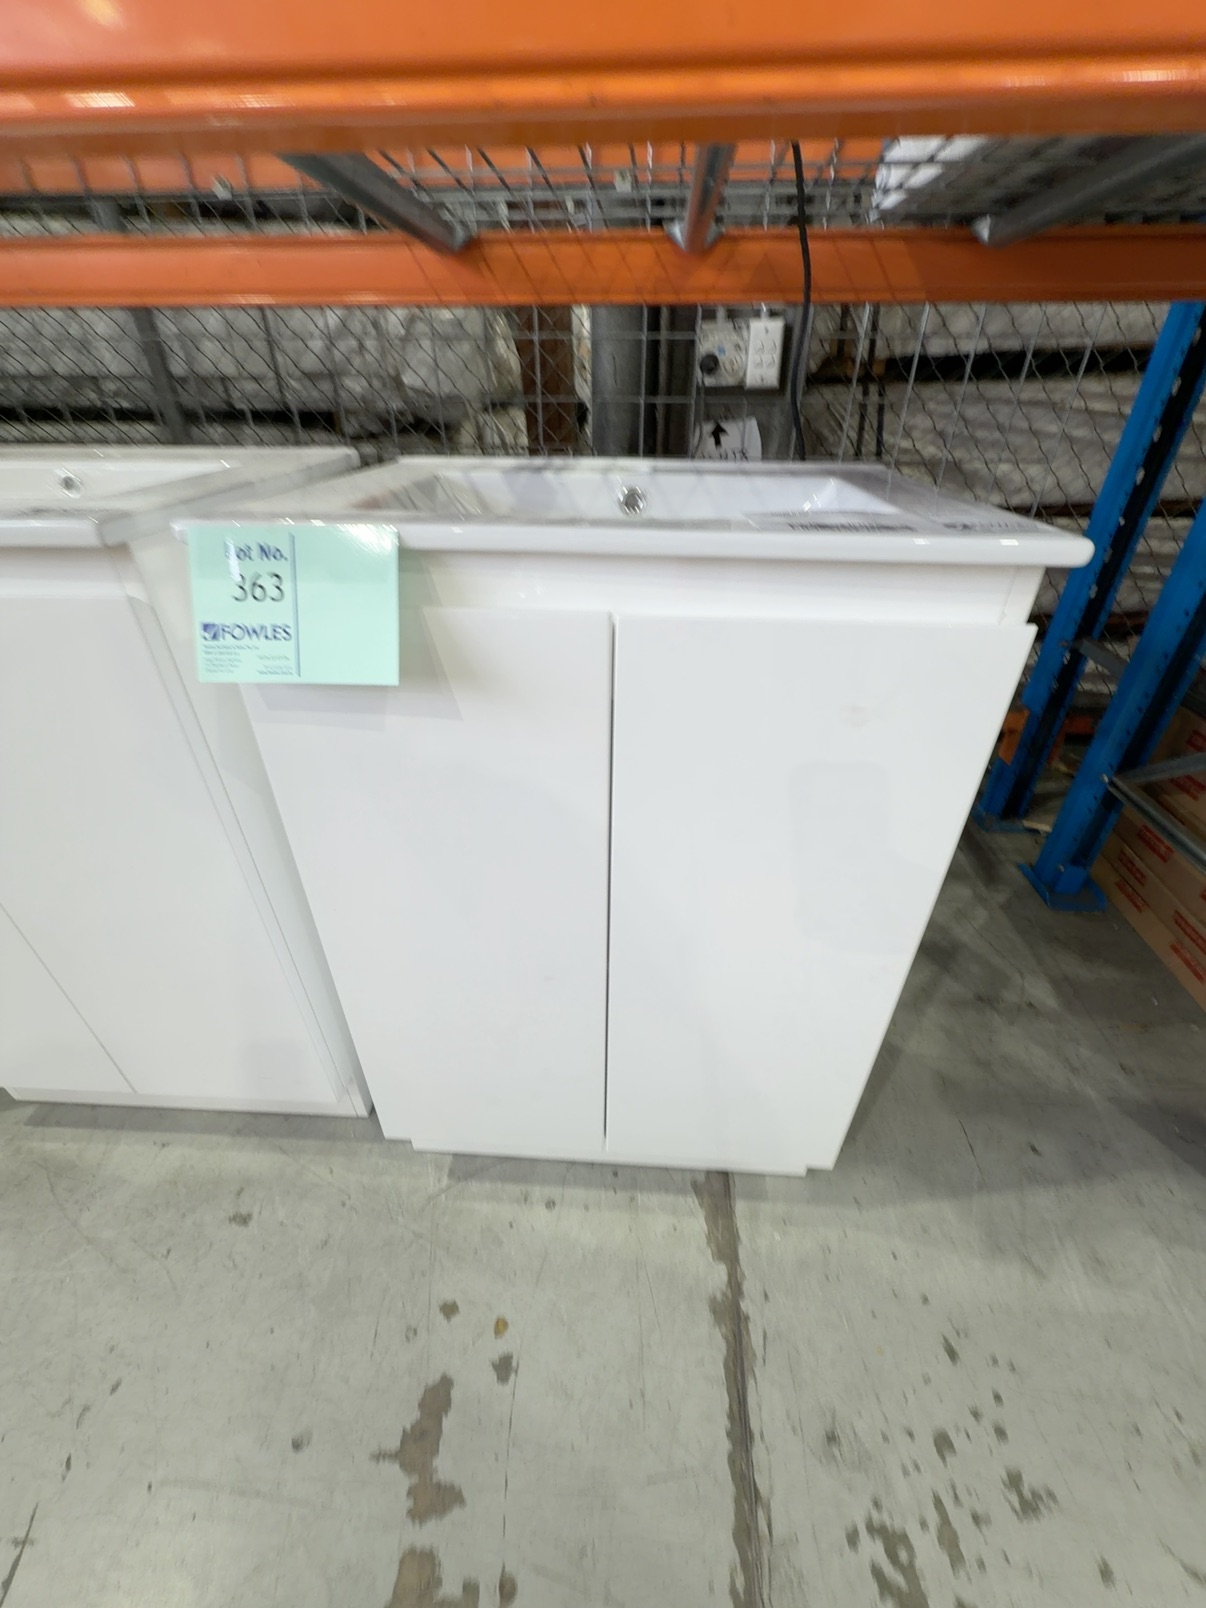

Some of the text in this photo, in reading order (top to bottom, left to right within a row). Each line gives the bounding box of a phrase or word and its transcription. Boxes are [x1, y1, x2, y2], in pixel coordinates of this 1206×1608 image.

[257, 541, 288, 561] No.
[232, 571, 285, 602] 363
[221, 622, 292, 641] FOWLES
